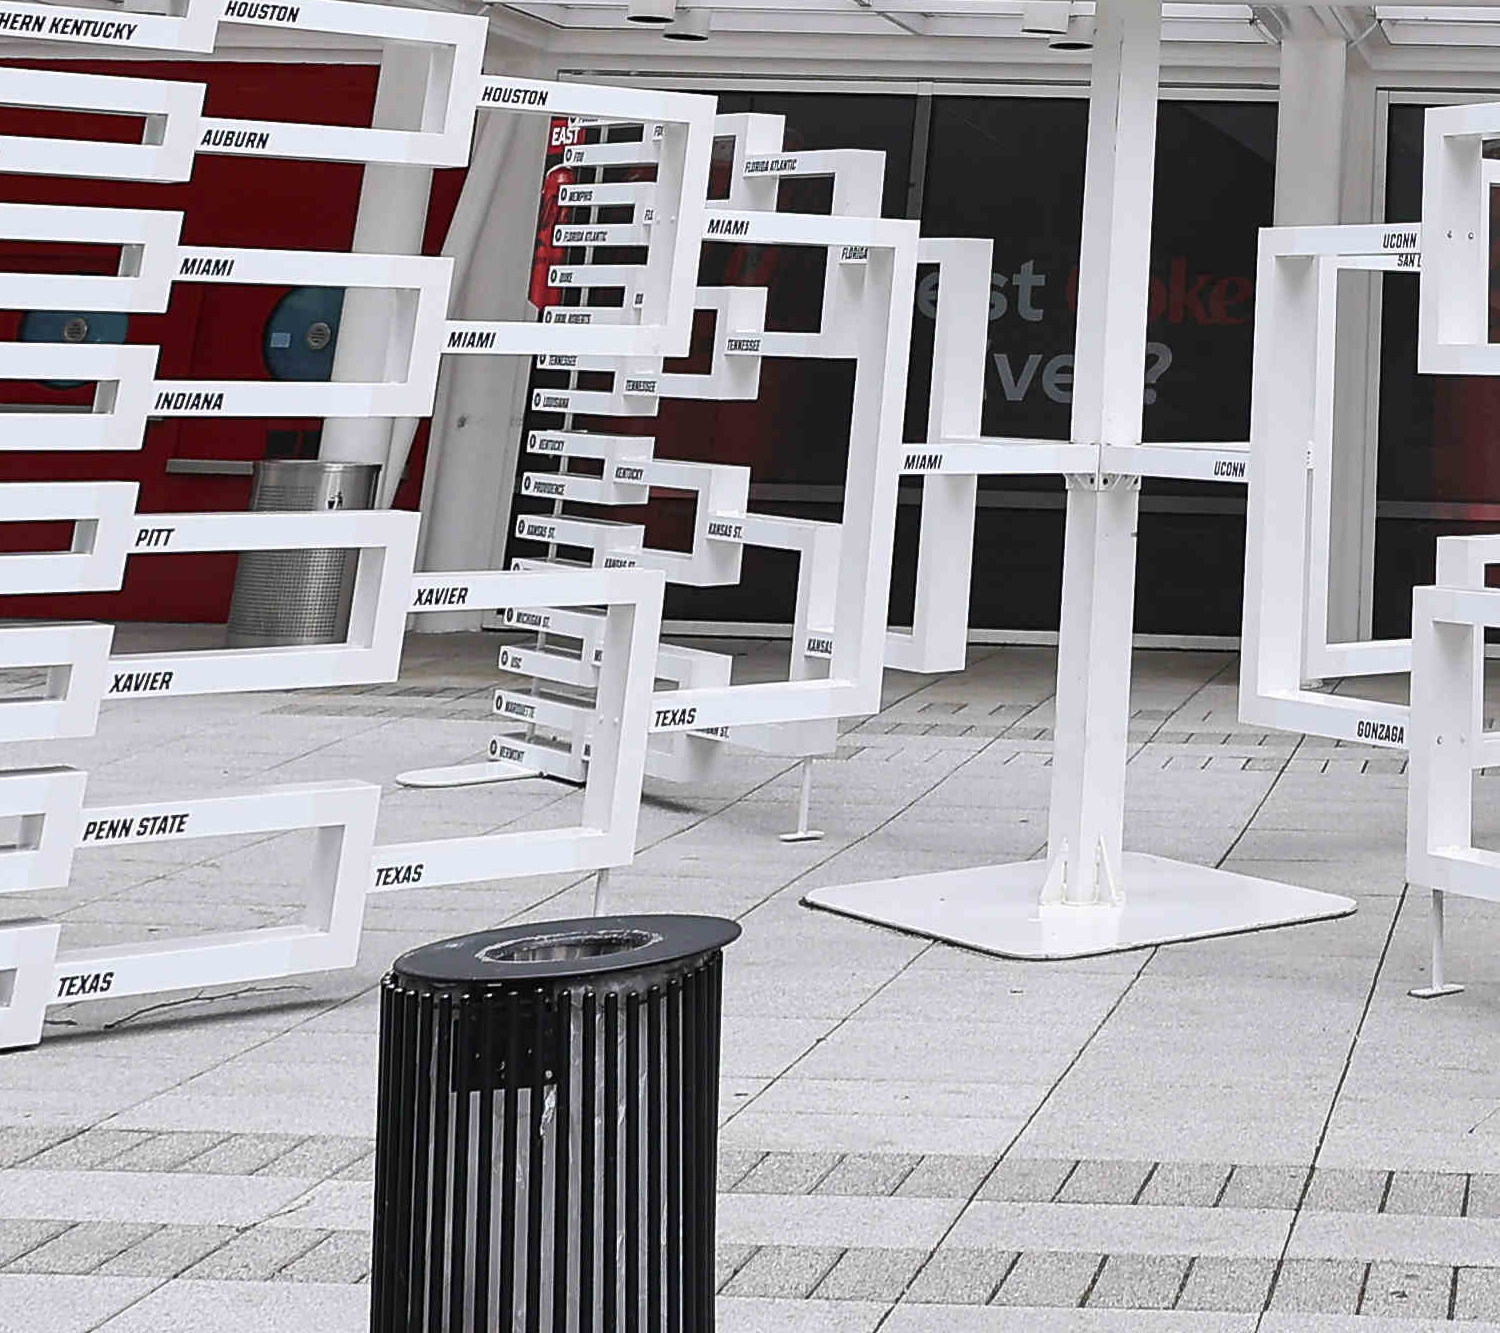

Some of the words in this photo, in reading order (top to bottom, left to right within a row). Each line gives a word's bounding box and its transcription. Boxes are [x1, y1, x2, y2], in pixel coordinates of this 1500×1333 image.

[225, 1, 299, 22] HOUSTON
[49, 17, 137, 40] KENTUCKY
[482, 87, 548, 109] HOUSTON
[201, 130, 269, 149] AUBURN
[552, 127, 580, 145] EAST
[708, 219, 749, 234] MIAMI
[1383, 233, 1417, 248] UCONN
[180, 258, 234, 276] MIAMI
[448, 332, 496, 348] MIAMI
[155, 393, 223, 410] INDIANA
[904, 455, 942, 469] MIAMI
[1214, 461, 1245, 477] UCONN
[136, 529, 175, 546] PITT
[414, 588, 468, 605] XAVIER
[109, 672, 173, 693] XAVIER
[655, 708, 696, 727] TEXAS
[1357, 721, 1403, 743] GONZAGA
[83, 819, 133, 841] PENN
[137, 814, 189, 836] STATE
[376, 864, 423, 886] TEXAS
[58, 972, 114, 997] TEXAS
